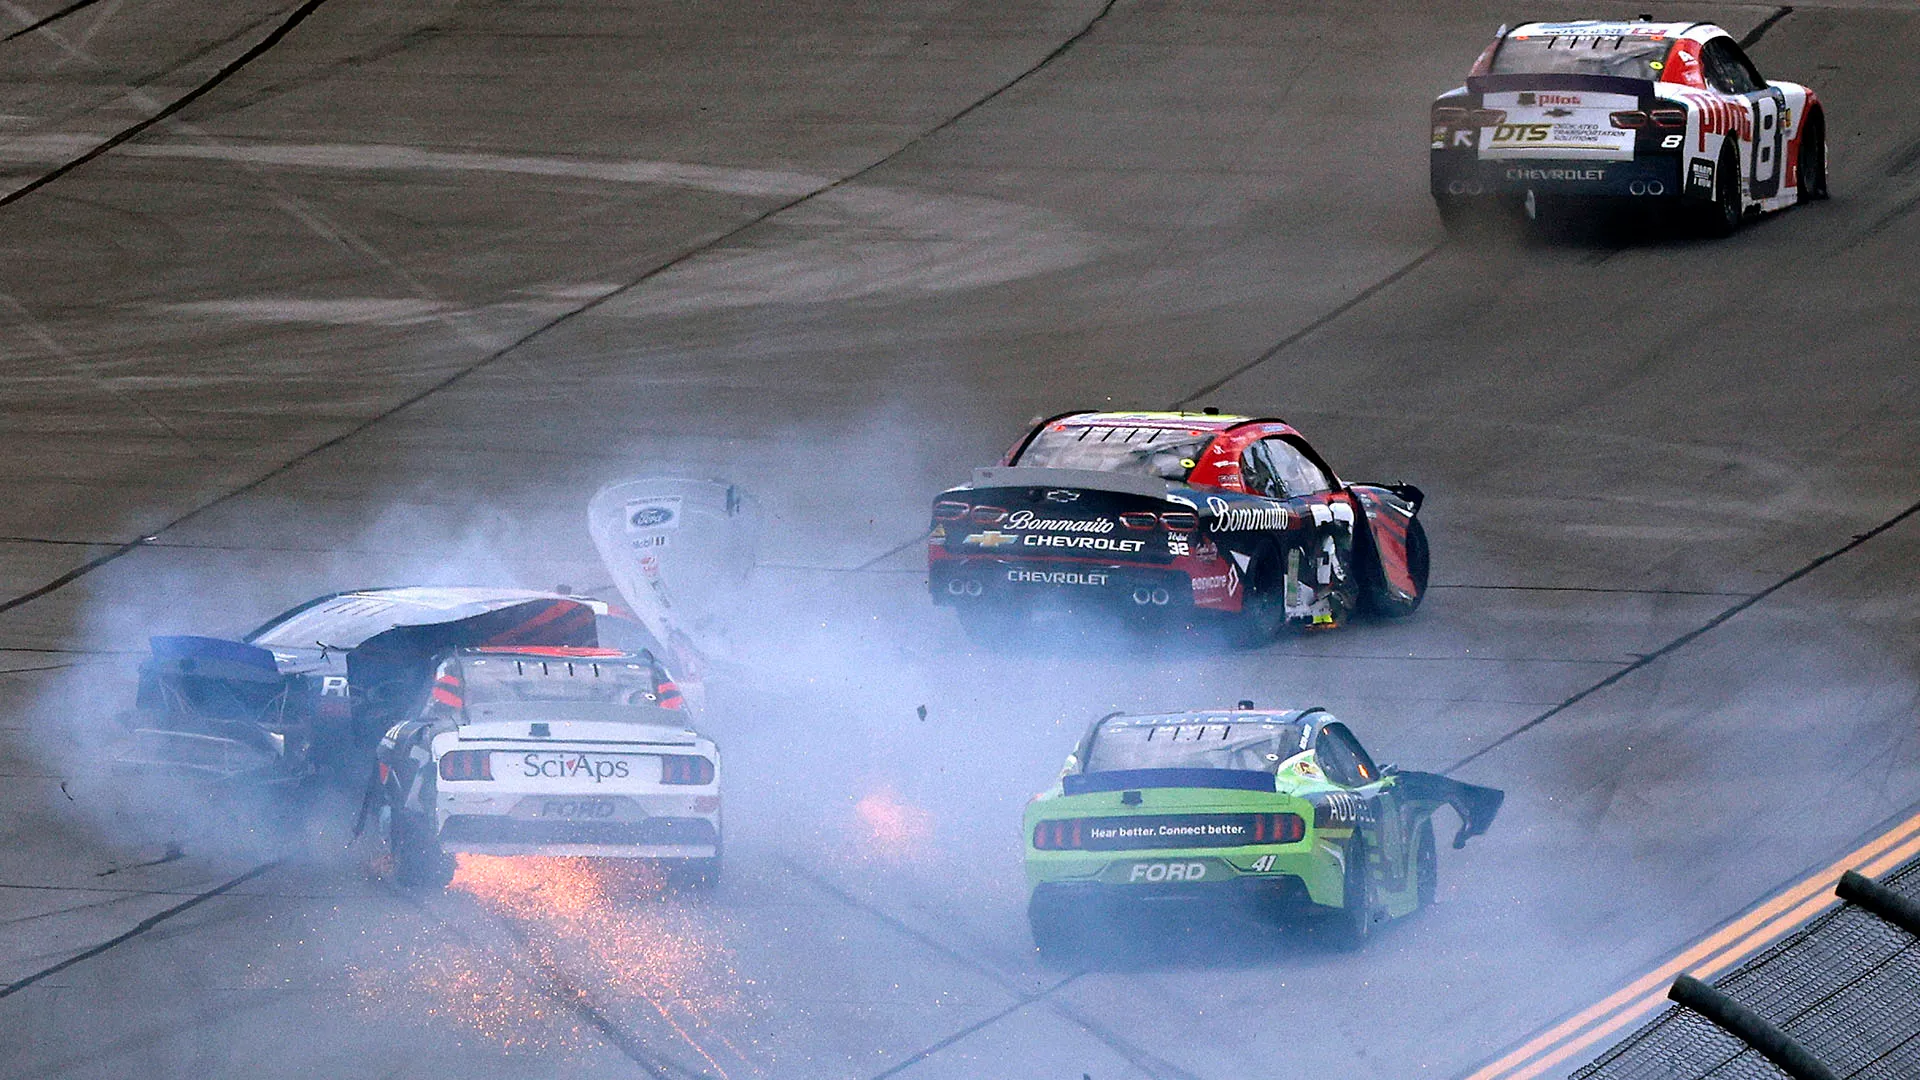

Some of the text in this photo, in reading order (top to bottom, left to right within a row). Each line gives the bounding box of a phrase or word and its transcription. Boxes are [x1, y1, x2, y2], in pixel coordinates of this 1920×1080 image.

[1493, 123, 1553, 142] DTS
[1661, 135, 1683, 148] 8
[1755, 96, 1778, 182] 8
[1506, 169, 1606, 180] CHEVROLET
[1003, 510, 1115, 534] Bommarito
[1207, 496, 1289, 533] Bommarito
[1023, 534, 1146, 552] CHEVROLET
[1168, 541, 1190, 556] 32
[1007, 570, 1109, 586] CHEVROLET
[523, 754, 630, 783] SciAps
[1091, 824, 1246, 838] Hear better. Connect better.
[1130, 863, 1206, 882] FORD
[1251, 855, 1277, 872] 41
